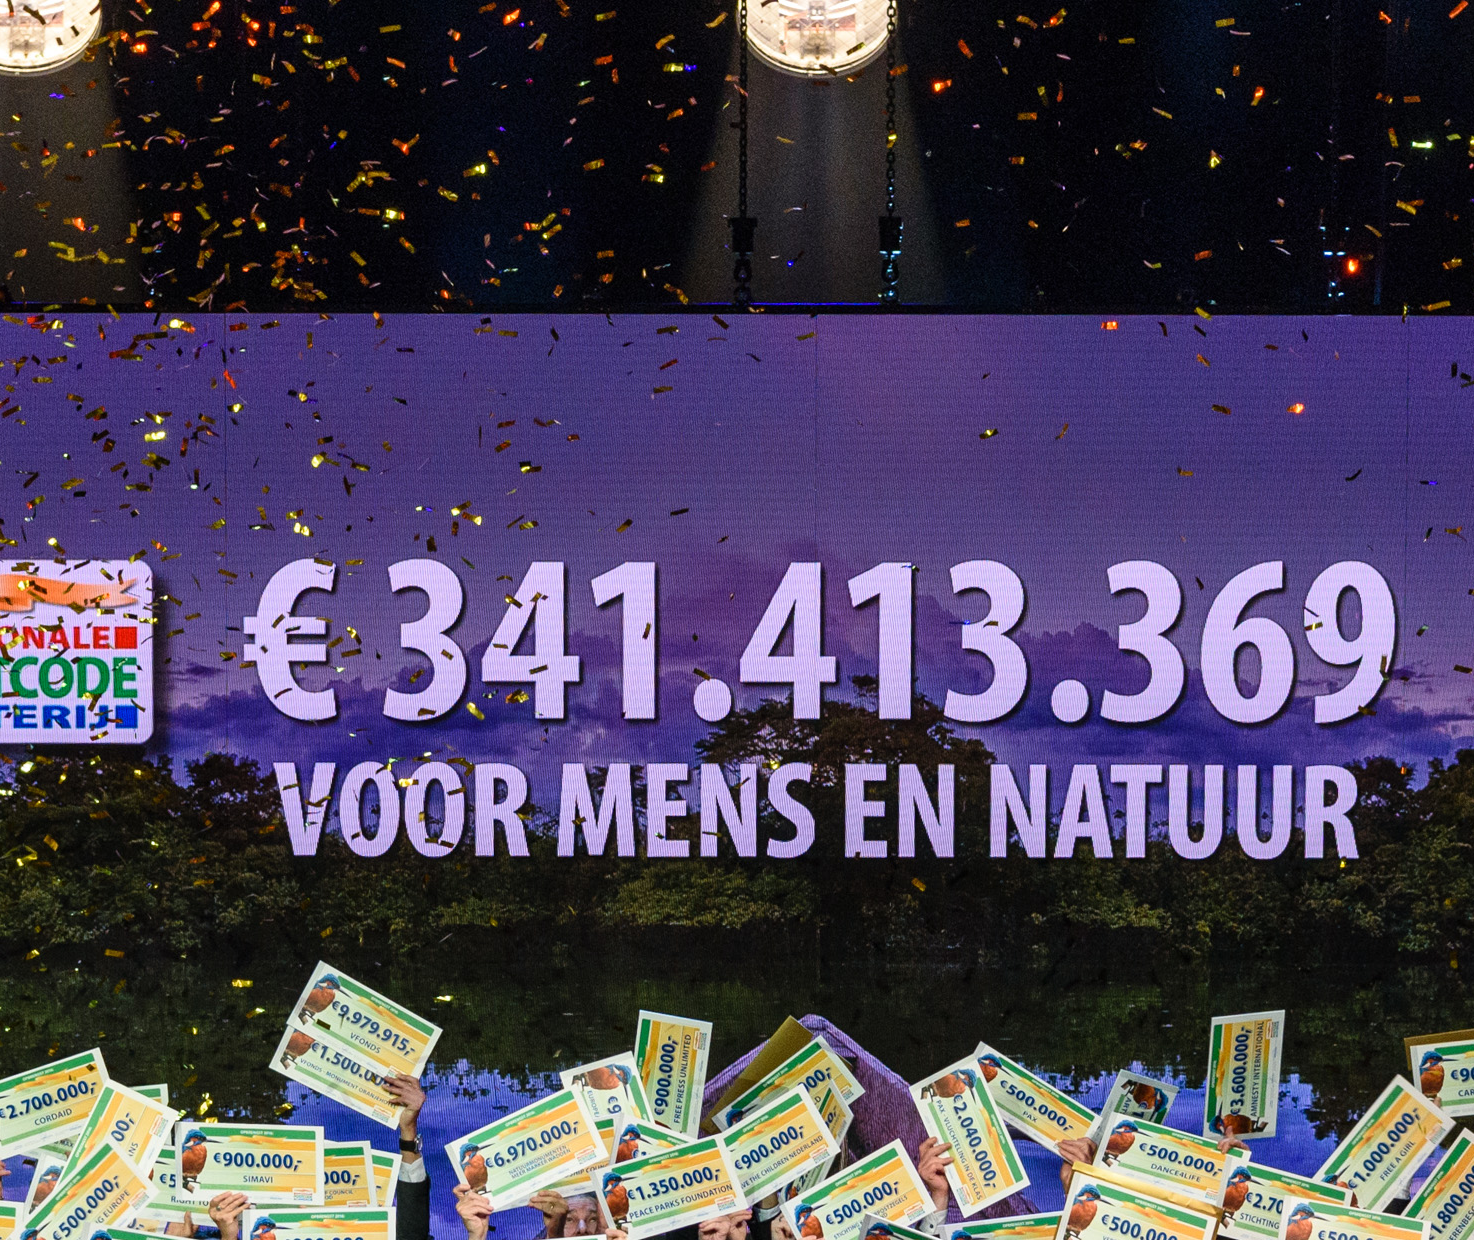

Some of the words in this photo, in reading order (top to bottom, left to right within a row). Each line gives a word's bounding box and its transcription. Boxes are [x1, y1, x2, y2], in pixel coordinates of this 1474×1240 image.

[242, 558, 337, 723] €
[380, 558, 1398, 725] 341.413.369
[273, 761, 530, 860] VOOR
[556, 761, 817, 861] MENS
[844, 762, 956, 860] EN
[989, 762, 1360, 861] NATUUR
[331, 999, 416, 1057] €9.979.915,-
[350, 1032, 381, 1054] VFONDS
[654, 1036, 679, 1116] €900.000,-
[1230, 1026, 1252, 1116] €3.600.000,-
[33, 1108, 74, 1127] CORDAID
[1000, 1079, 1075, 1133] €500.000,-
[213, 1152, 302, 1172] €900.000,-
[485, 1120, 579, 1169] €6.970.000,-
[734, 1126, 805, 1170] €900.000,-
[953, 1094, 997, 1188] €2.040.000,-
[1139, 1142, 1224, 1176] €500.000,-
[1348, 1107, 1422, 1189] €1.000.000,-
[627, 1166, 722, 1202] €1.350.000,-
[680, 1183, 733, 1207] FOUNDATION
[1150, 1163, 1202, 1183] DANCE4LIFE
[52, 1174, 121, 1240] €500.000,-
[825, 1179, 900, 1225] €500.000,-
